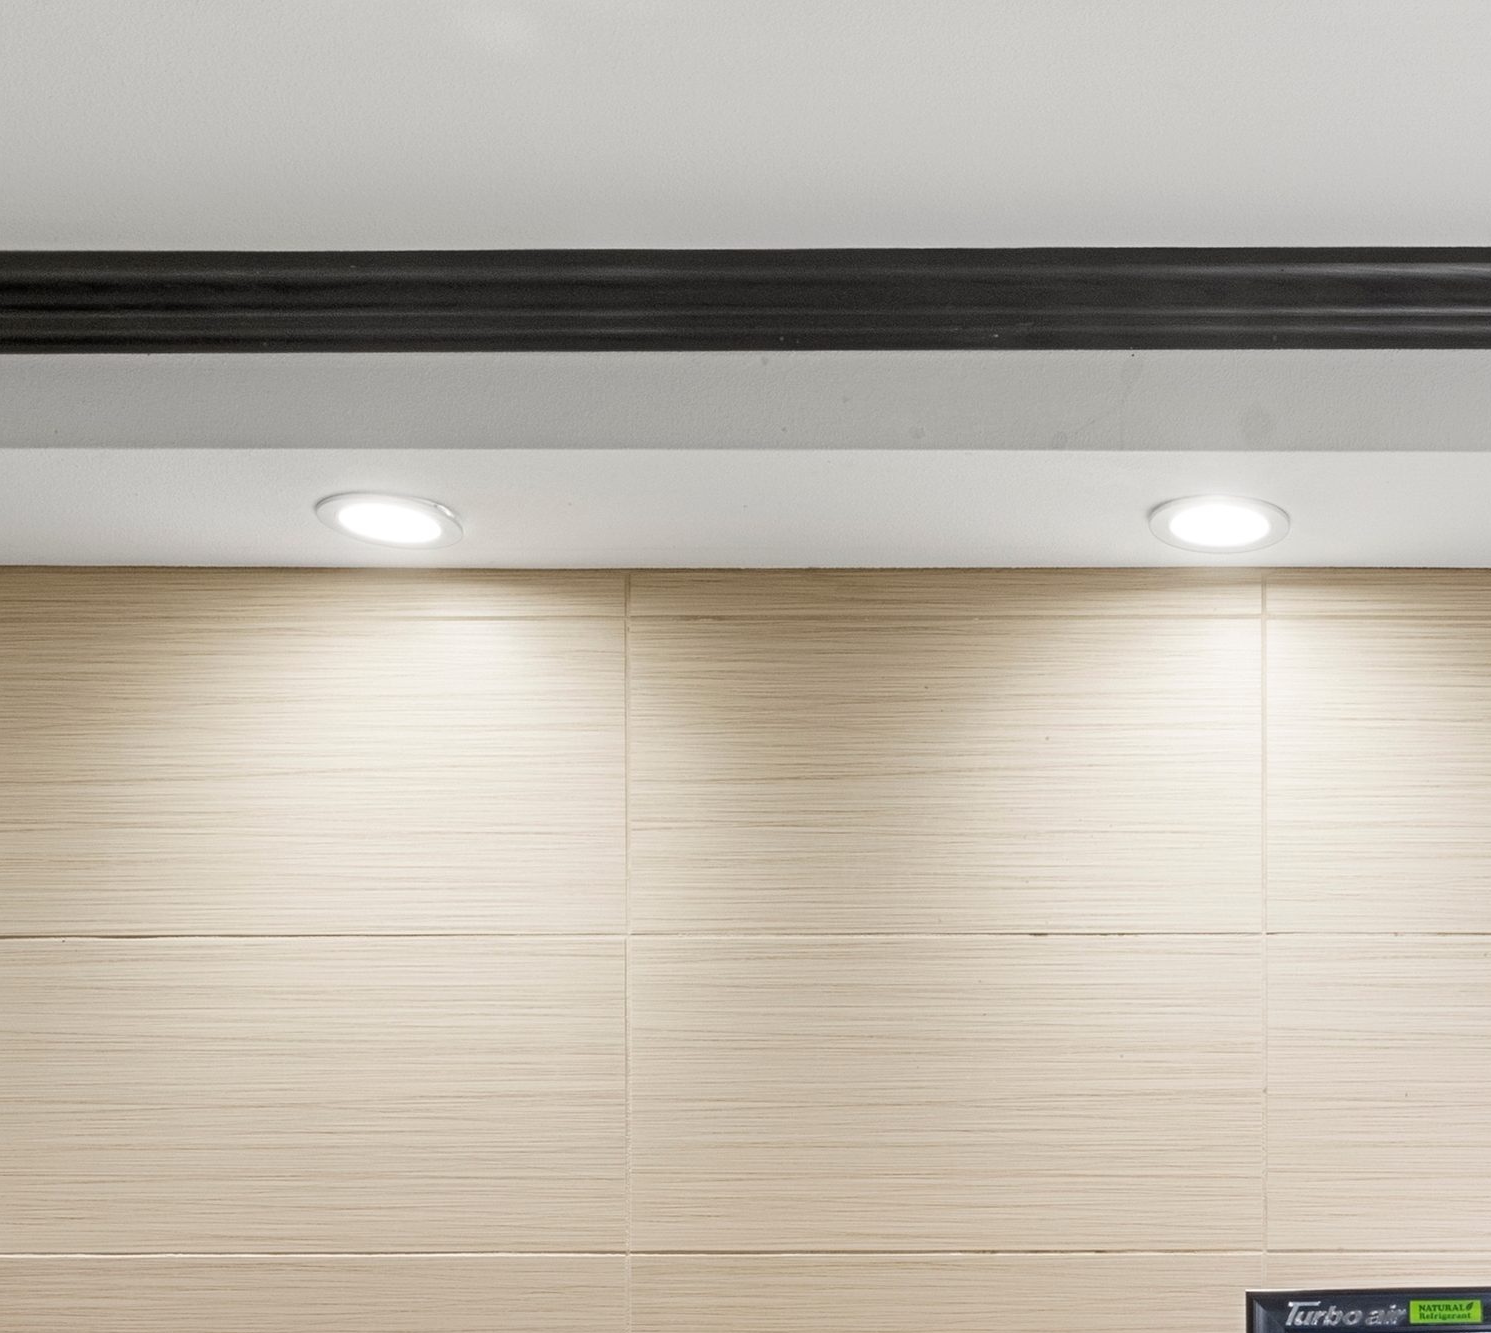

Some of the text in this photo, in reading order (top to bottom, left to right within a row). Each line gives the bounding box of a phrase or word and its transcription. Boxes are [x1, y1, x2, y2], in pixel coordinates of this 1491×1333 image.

[1419, 1304, 1465, 1312] NATURAL
[1285, 1301, 1407, 1326] Turbo air
[1419, 1312, 1471, 1321] Refrigerant
